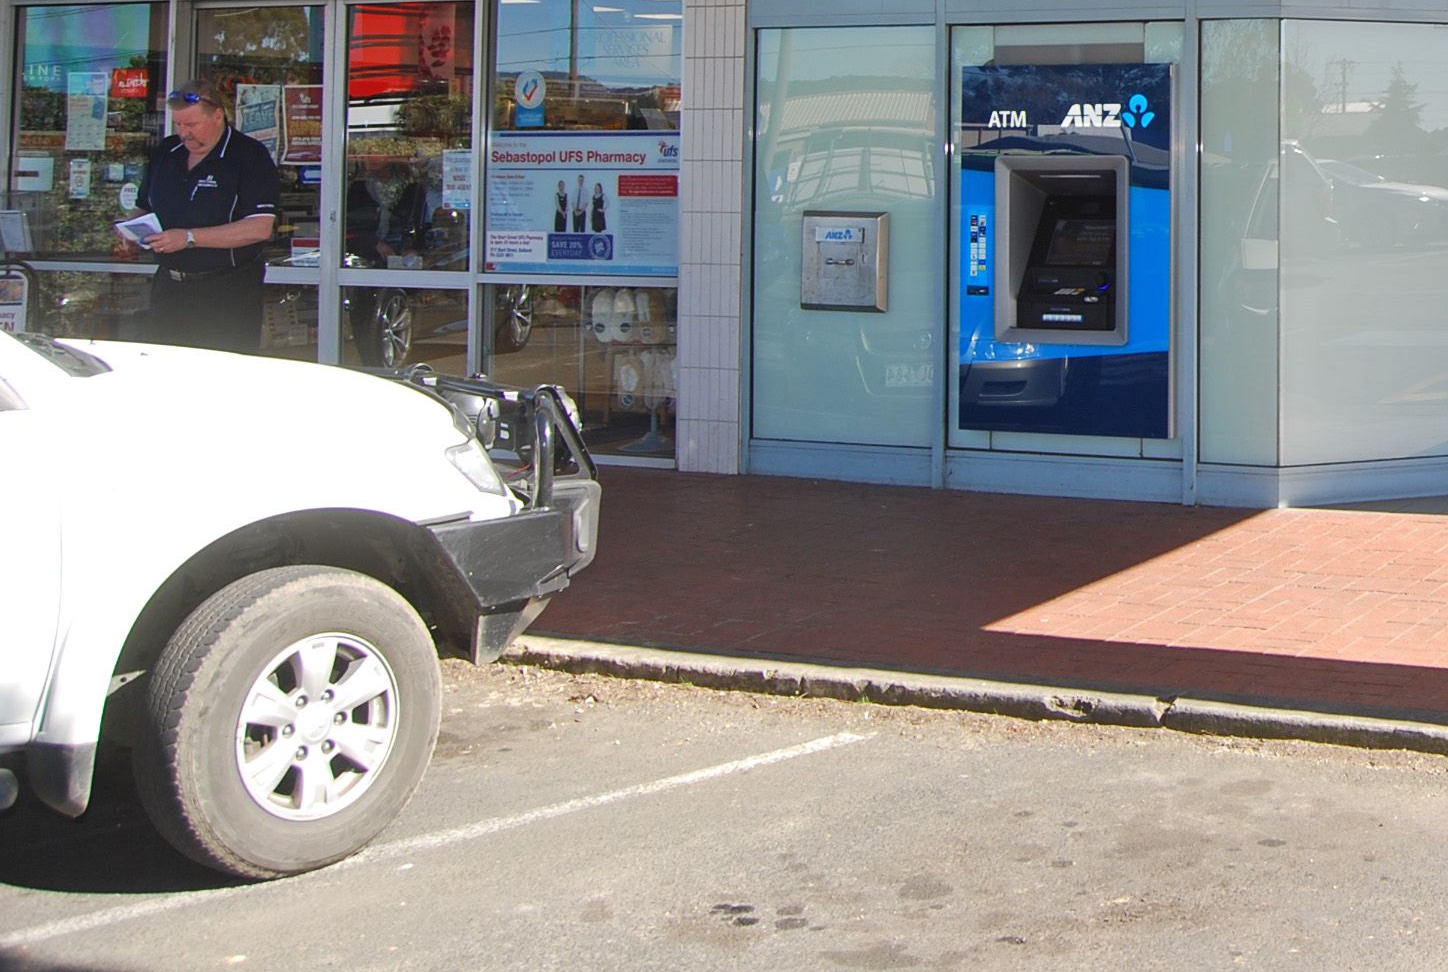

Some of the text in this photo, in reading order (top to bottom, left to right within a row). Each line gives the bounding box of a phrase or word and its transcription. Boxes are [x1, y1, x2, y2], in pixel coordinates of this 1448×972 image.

[988, 103, 1121, 128] ATM ANZ
[491, 150, 647, 165] Sebastopol UFS Pharmacy
